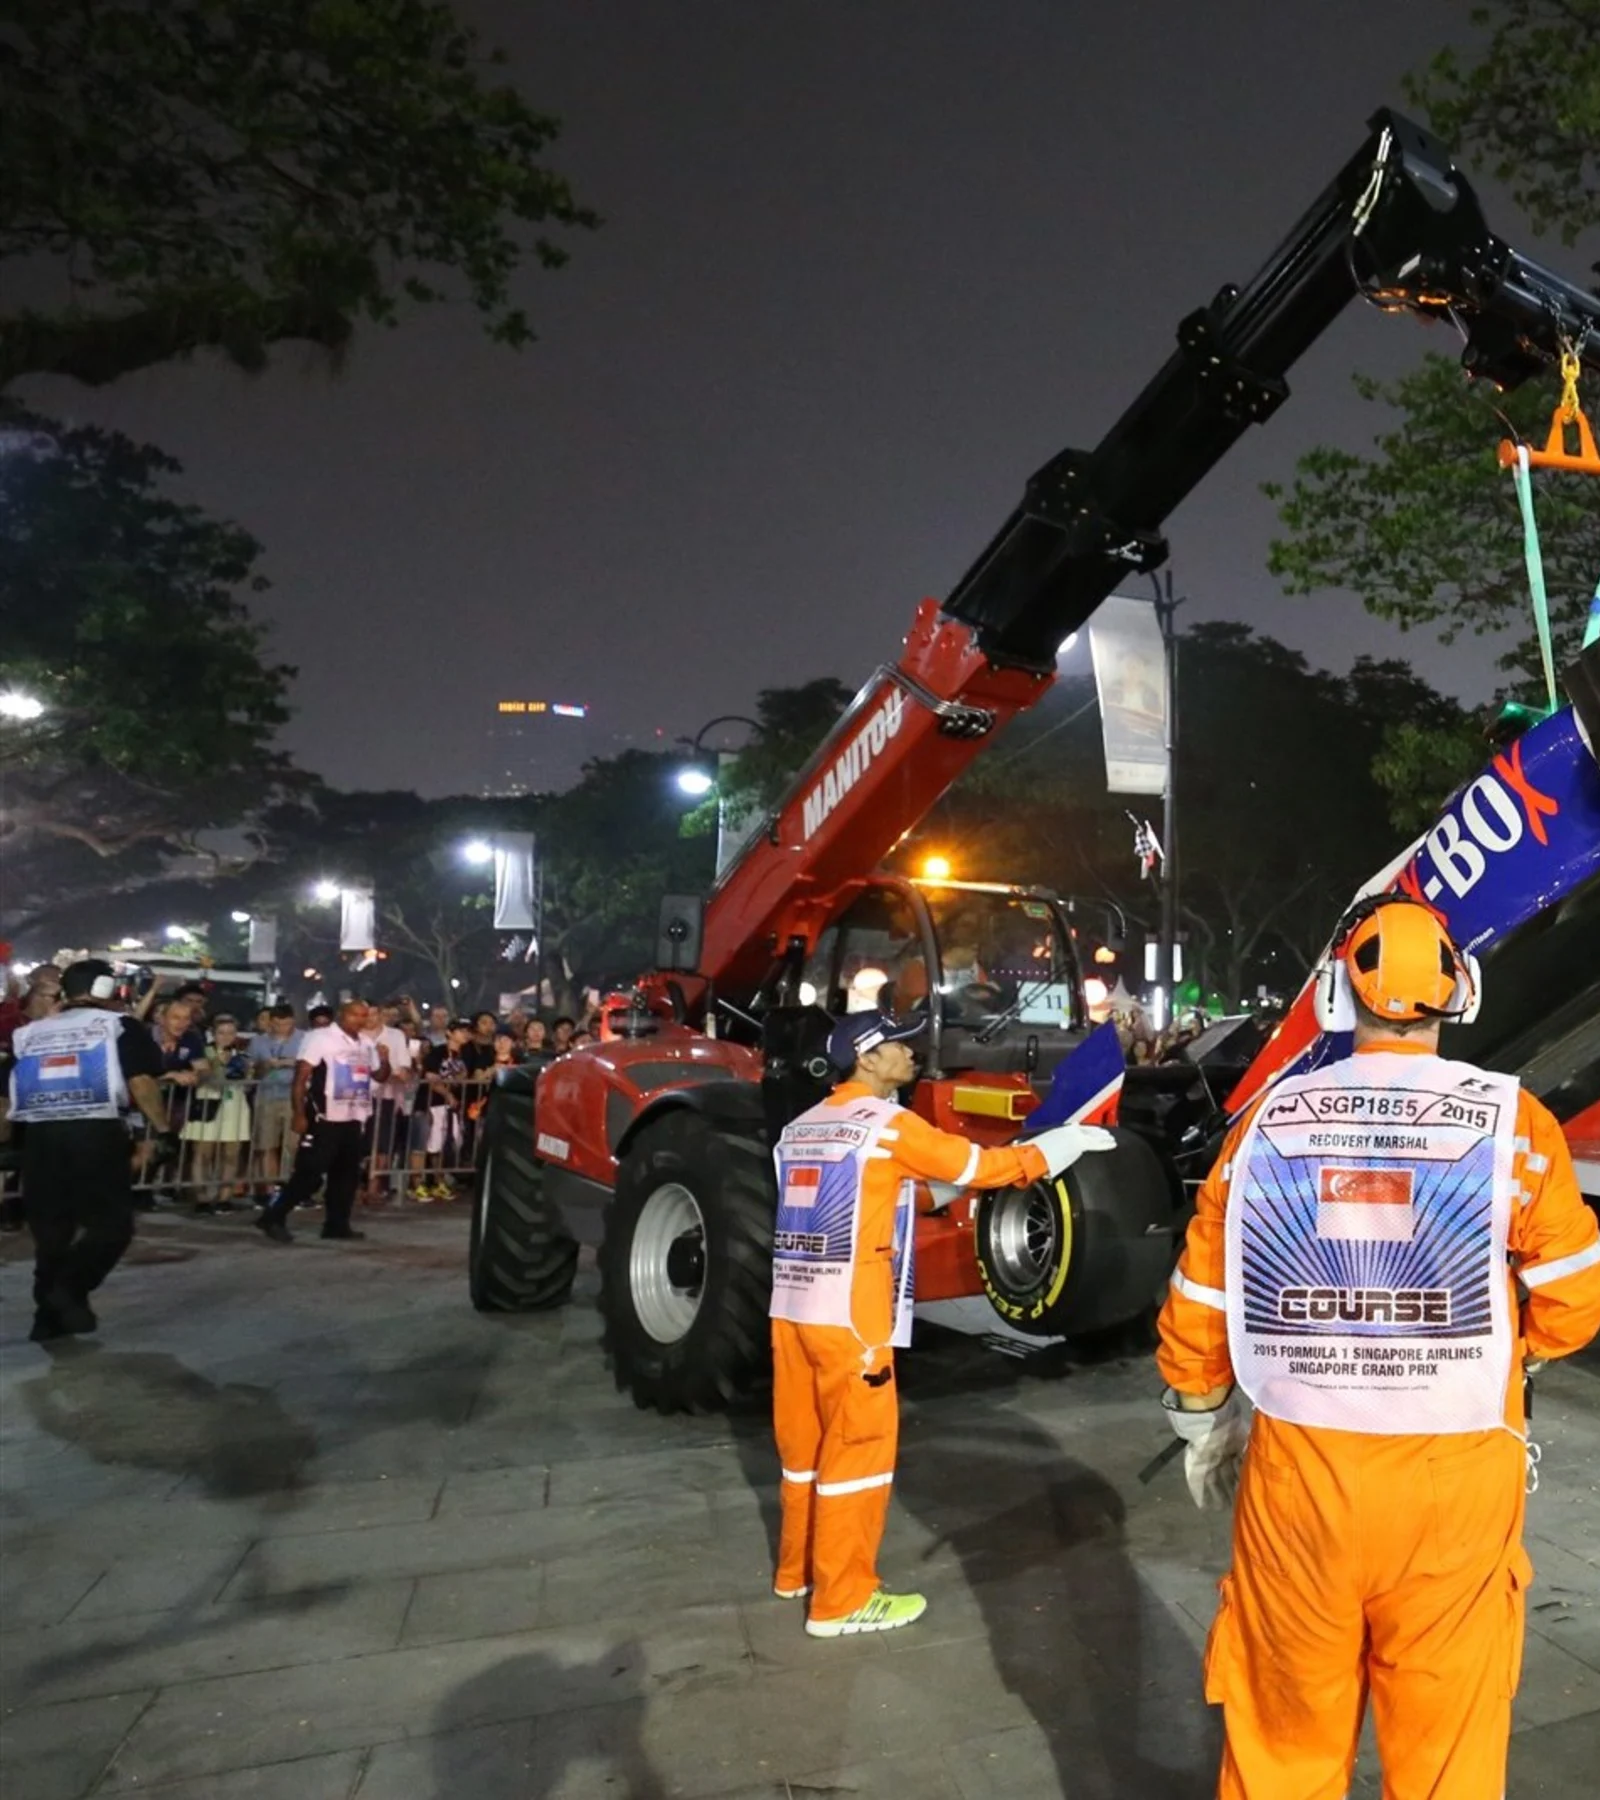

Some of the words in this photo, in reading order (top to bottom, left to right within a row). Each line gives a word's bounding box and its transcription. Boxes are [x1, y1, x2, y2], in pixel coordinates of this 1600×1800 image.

[803, 687, 903, 841] MANITOU
[1318, 1096, 1418, 1118] SGP1855
[1441, 1101, 1488, 1129] 2015
[1309, 1133, 1370, 1148] RECOVERY
[1373, 1135, 1429, 1150] MARSHAL
[1279, 1288, 1450, 1324] COURSE
[1253, 1343, 1277, 1357] 2015
[1280, 1345, 1337, 1359] FORMULA
[1342, 1348, 1348, 1359] 1
[1353, 1347, 1423, 1361] SINGAPORE
[1426, 1346, 1482, 1360] AIRLINES
[1288, 1361, 1357, 1375] SINGAPORE
[1361, 1363, 1405, 1376] GRAND
[1408, 1363, 1439, 1376] PRIX
